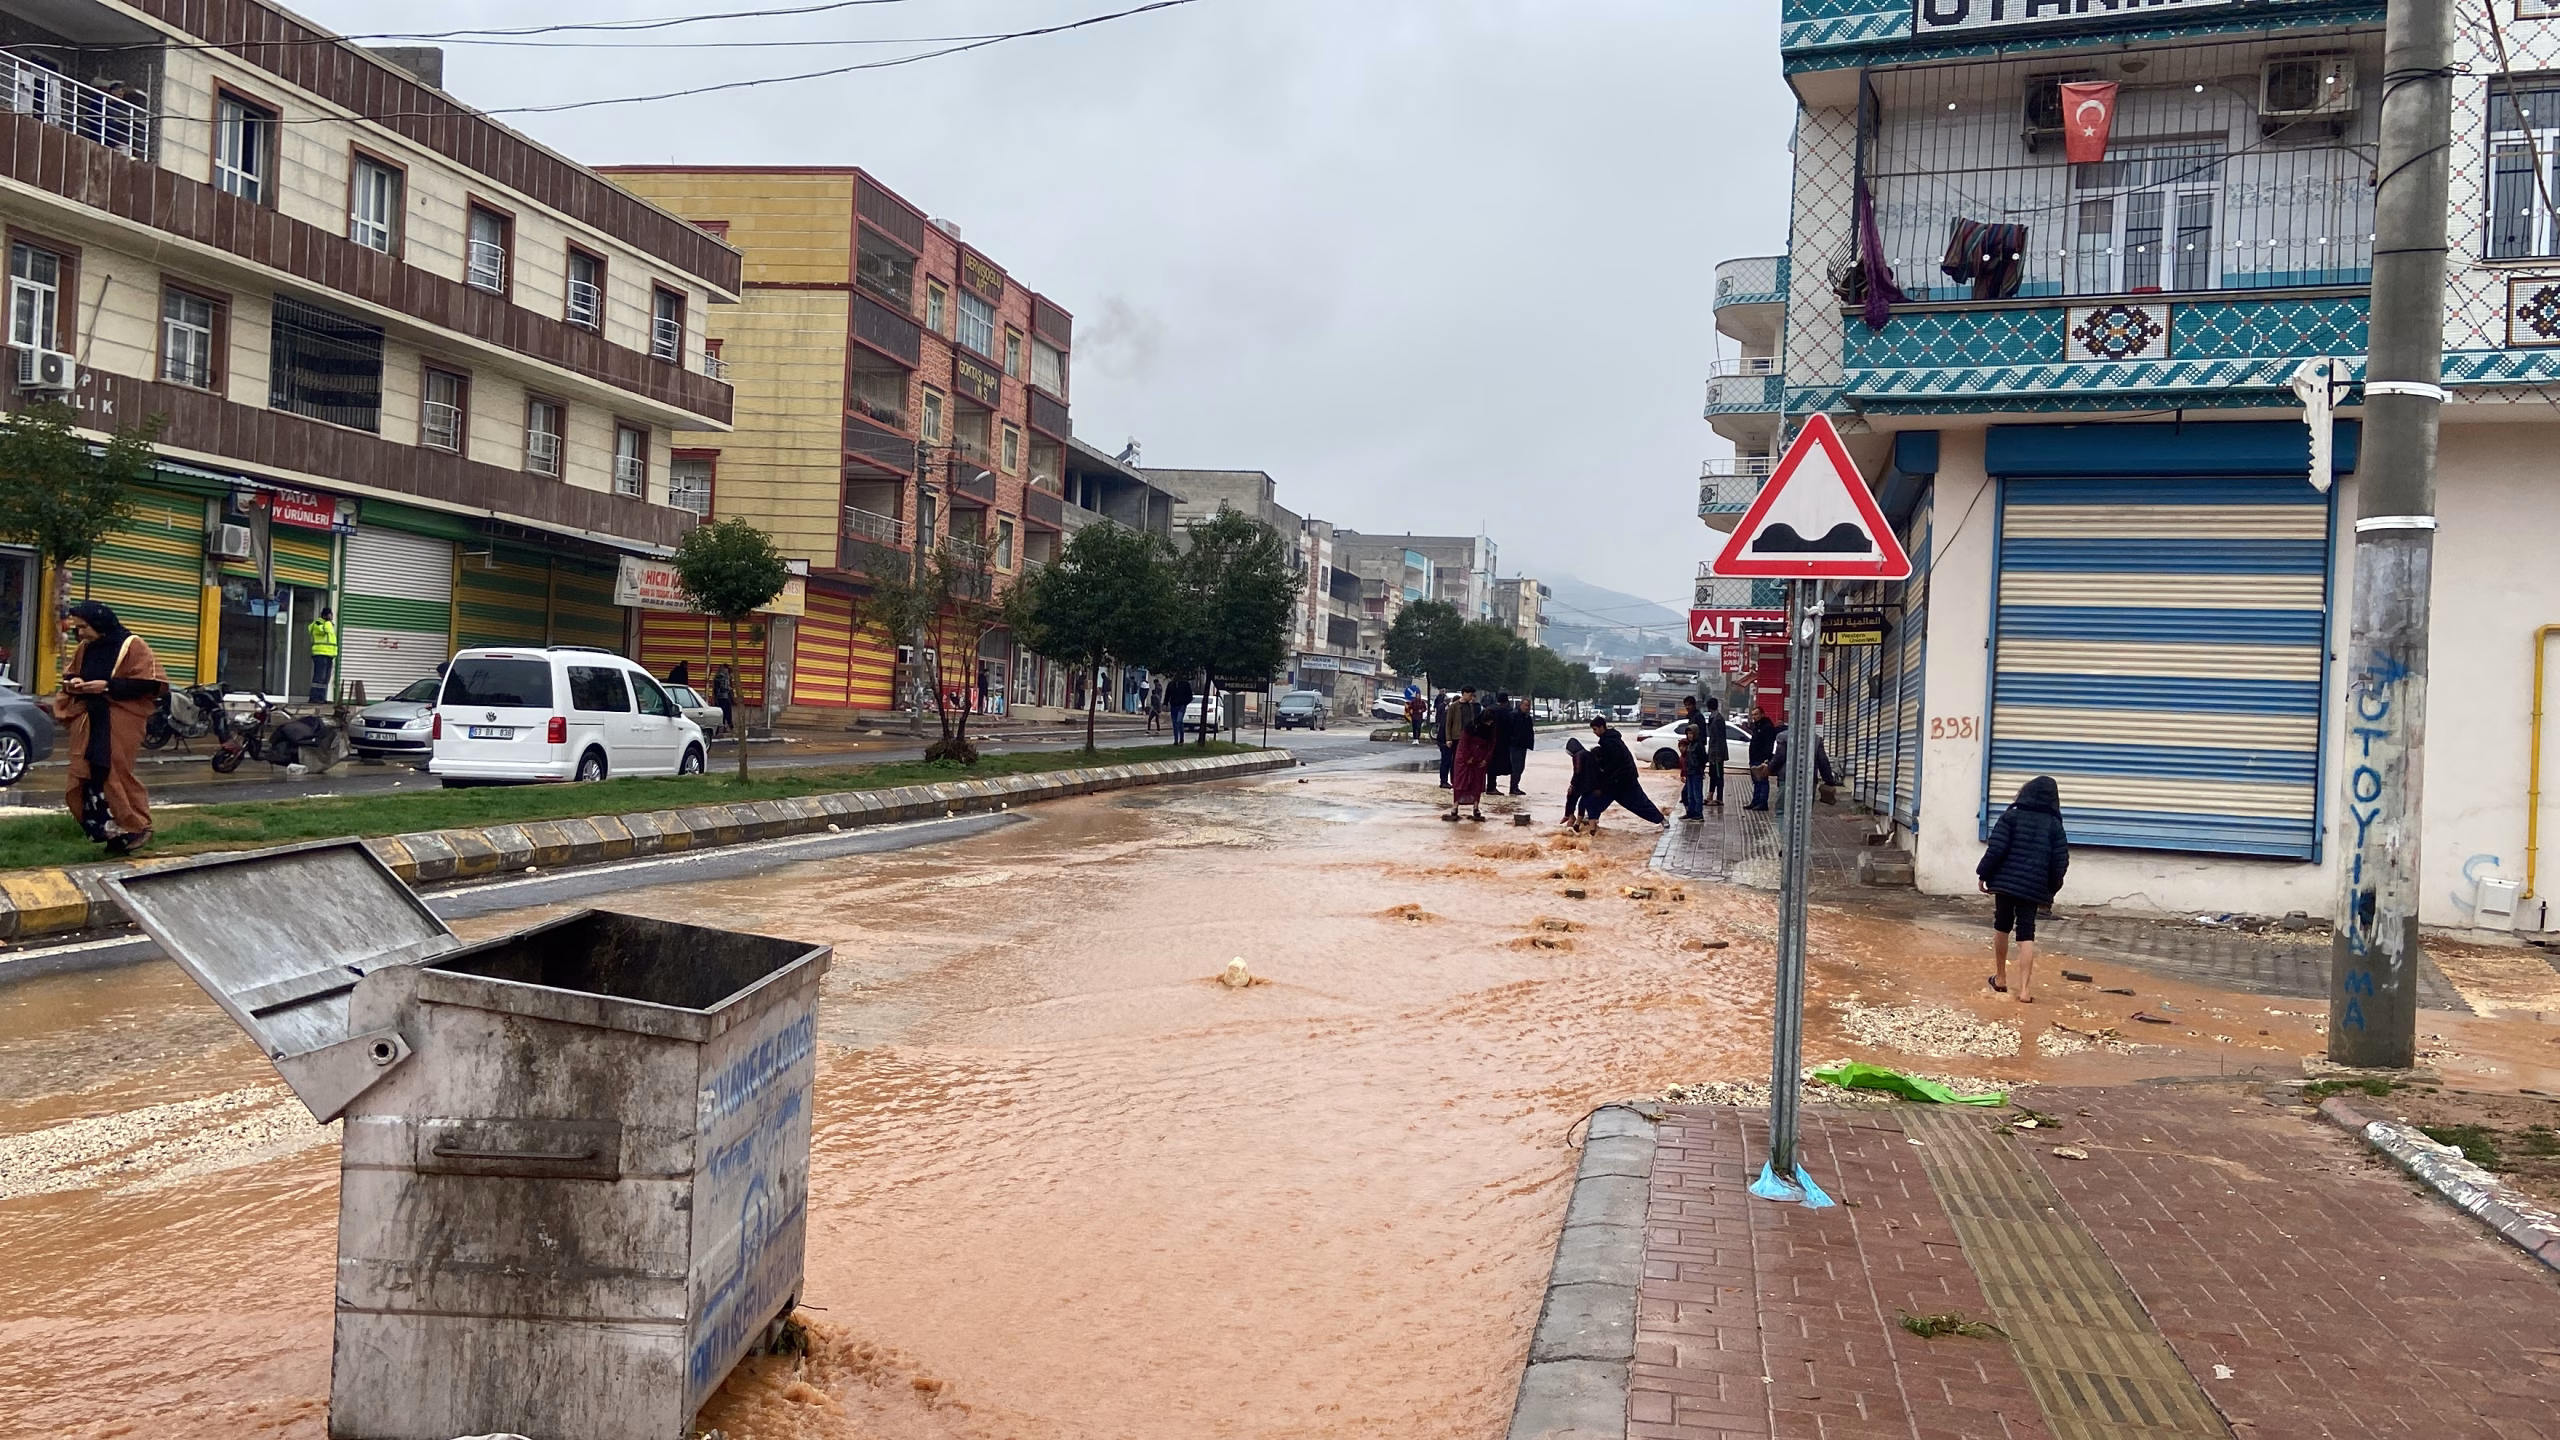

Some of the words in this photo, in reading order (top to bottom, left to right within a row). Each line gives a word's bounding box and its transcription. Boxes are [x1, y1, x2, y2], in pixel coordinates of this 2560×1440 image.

[983, 372, 998, 391] YAPI
[280, 491, 318, 508] YAYLA
[284, 504, 330, 526] ÜRÜNLERİ
